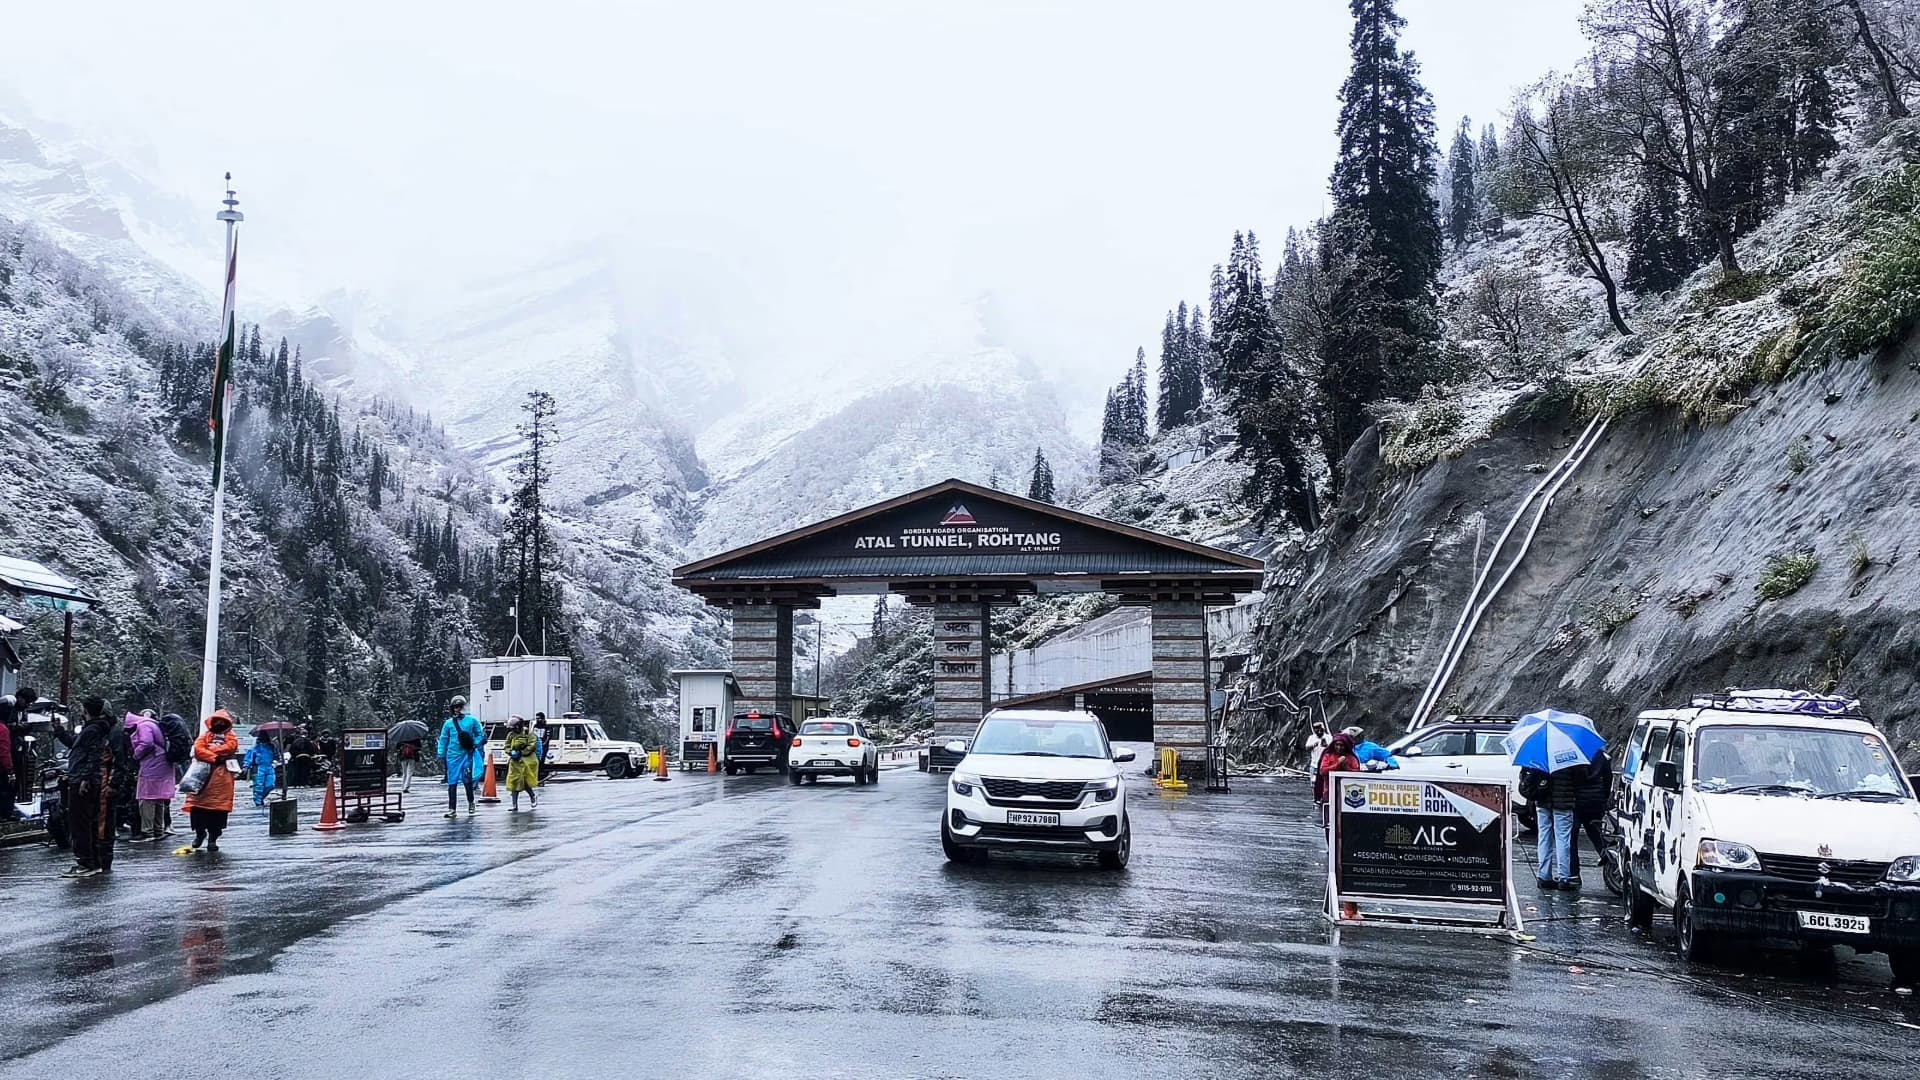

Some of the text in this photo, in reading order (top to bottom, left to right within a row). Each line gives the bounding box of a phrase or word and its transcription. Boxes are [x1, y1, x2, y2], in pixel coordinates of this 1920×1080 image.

[854, 532, 1061, 549] ATAL TUNNEL, ROHTANG
[944, 622, 972, 633] अटल
[945, 642, 973, 652] टनल
[1368, 783, 1395, 791] HIMACHAL
[1368, 792, 1420, 807] POLICE
[1412, 825, 1457, 846] ALC
[1357, 851, 1490, 865] RESIDENTIAL COMMERCIAL INDUSTRIAL
